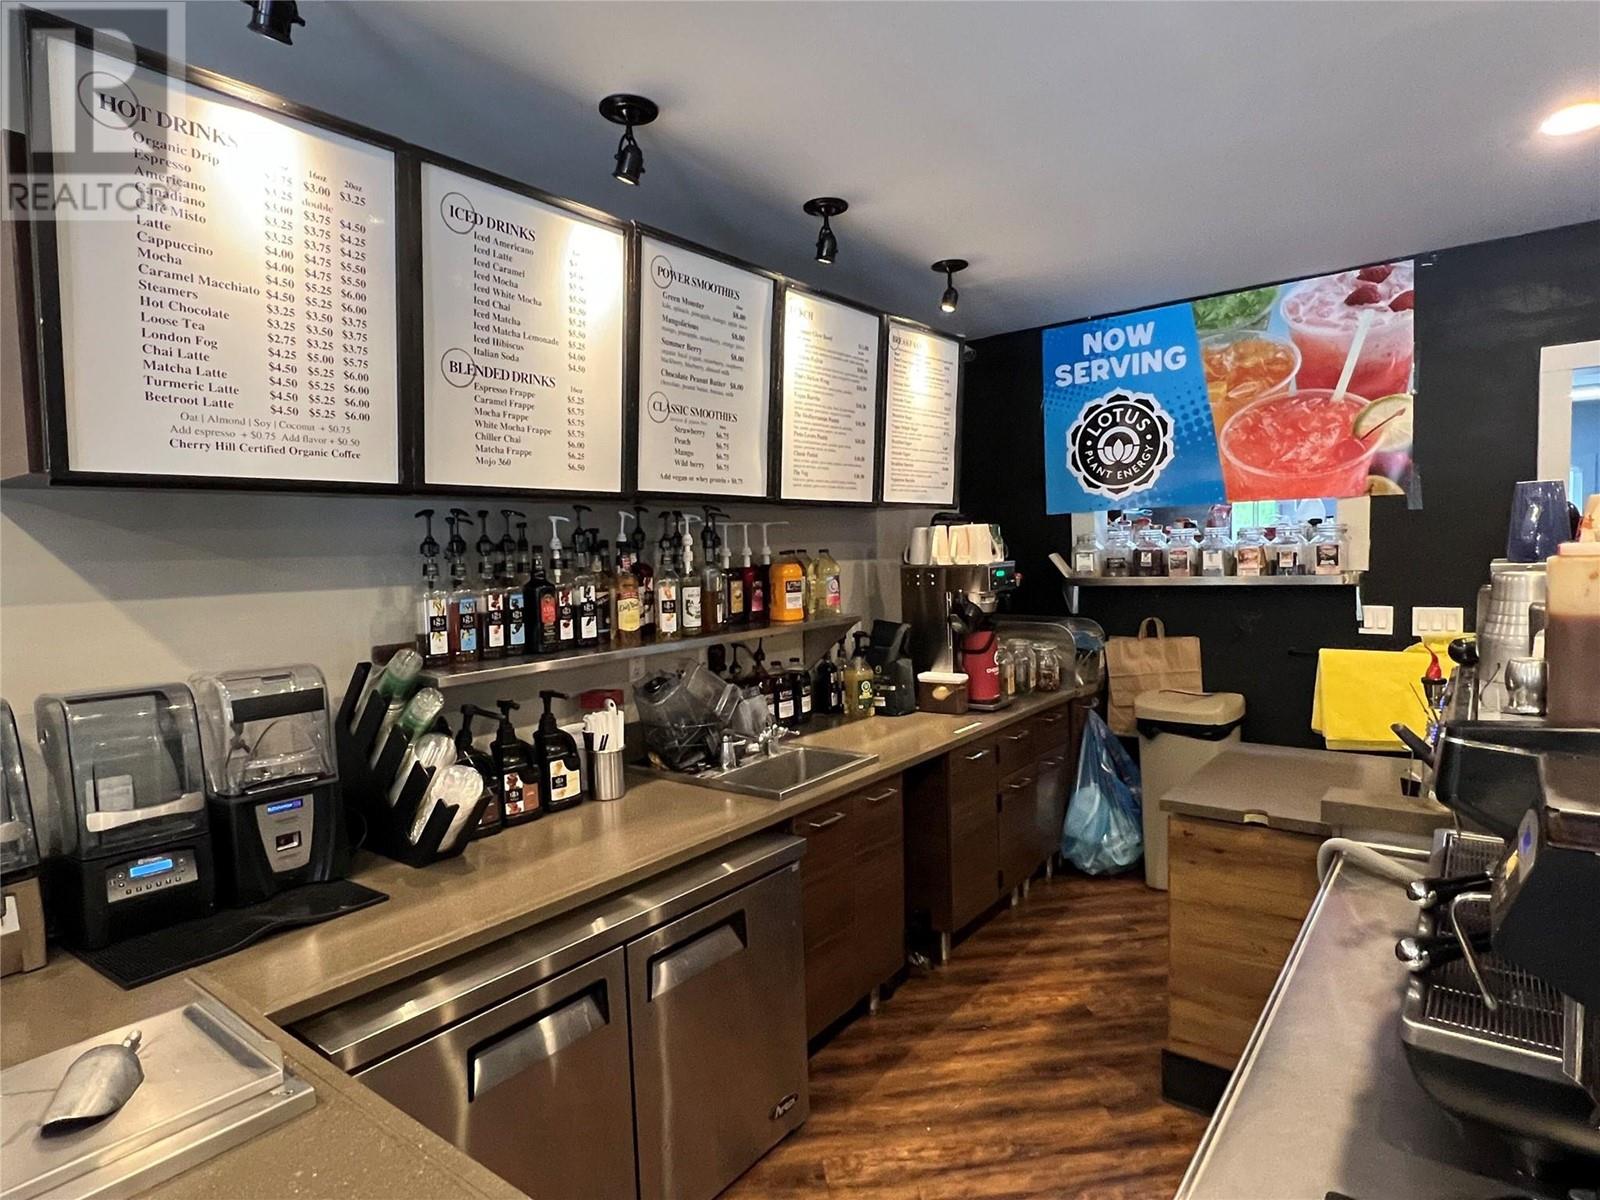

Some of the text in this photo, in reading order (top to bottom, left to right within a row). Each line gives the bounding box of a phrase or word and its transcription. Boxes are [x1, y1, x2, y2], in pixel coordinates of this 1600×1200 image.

[99, 92, 151, 121] HOT
[133, 131, 366, 207] Organic Drip $3.00 $3.25
[134, 149, 191, 173] Espresso
[344, 180, 363, 193] 20oz
[134, 165, 366, 234] Americano $3.75 $4.50
[135, 182, 366, 248] Canadiano $3.75 $4.25
[450, 204, 536, 242] ICED DRINKS
[136, 214, 367, 276] Latte $4.75 $5.50
[171, 206, 206, 224] Misto
[304, 239, 331, 254] $3.75
[339, 247, 366, 262] $4.25
[474, 231, 534, 256] Iced Americano
[136, 230, 367, 289] Cappuccino $4.00 $4.75 $5.50
[474, 244, 513, 262] Iced Latte
[137, 246, 367, 302] Mocha $4.50 $5.25 $6.00
[474, 257, 525, 278] Iced Caramel
[474, 270, 519, 289] Iced Mocha
[138, 263, 367, 316] Caramel Macchiato $4.50 $5.25 $6.00
[474, 283, 542, 307] Iced White Mocha
[657, 266, 740, 301] POWER SMOOTHIES
[138, 279, 368, 329] Steamers $3.25 $3.50 $3.75
[474, 296, 511, 312] Iced Chai
[662, 291, 680, 303] Green
[140, 295, 368, 343] Hot Chocolate $3.25 $3.50 $3.75
[473, 309, 521, 327] Iced Matcha
[140, 311, 369, 356] Loose Tea $2.75 $3.25 $3.75
[473, 321, 559, 346] Iced Matcha Lemonade
[473, 334, 525, 351] Iced Hibiscus
[1083, 321, 1155, 355] NOW
[141, 327, 369, 369] London Fog $4.25 $5.00 $5.75
[473, 346, 520, 362] Italian Soda
[687, 344, 702, 355] Berry
[142, 343, 369, 382] Chai Latte $4.50 $5.25 $6.00
[450, 360, 556, 388] BLENDED DRINKS
[661, 368, 688, 380] Chocolate
[1054, 346, 1187, 387] SERVING
[143, 359, 370, 396] Matcha Latte $4.50 $5.25 $6.00
[143, 375, 370, 409] Turmeric Latte $4.50 $5.25 $6.00
[474, 382, 535, 399] Espresso Frappe
[474, 395, 535, 411] Caramel Frappe
[145, 391, 371, 422] Beetroot Latte $4.50 $5.25 $6.00
[474, 407, 529, 422] Mocha Frappe
[653, 401, 689, 416] CLASSIC
[690, 407, 738, 423] SMOOTHIES
[180, 412, 315, 432] Oat Almond Soy Coconut
[475, 419, 552, 436] White Mocha Frappe
[1087, 408, 1151, 437] LOTUS
[170, 425, 327, 445] Add espresso Add flavor
[475, 432, 521, 444] Chiller Chai
[169, 438, 361, 460] Cherry Hill Certified Organic Coffee
[475, 444, 532, 457] Matcha Frappe
[475, 457, 496, 467] Mojo
[1084, 444, 1154, 480] PLANT ENERGY
